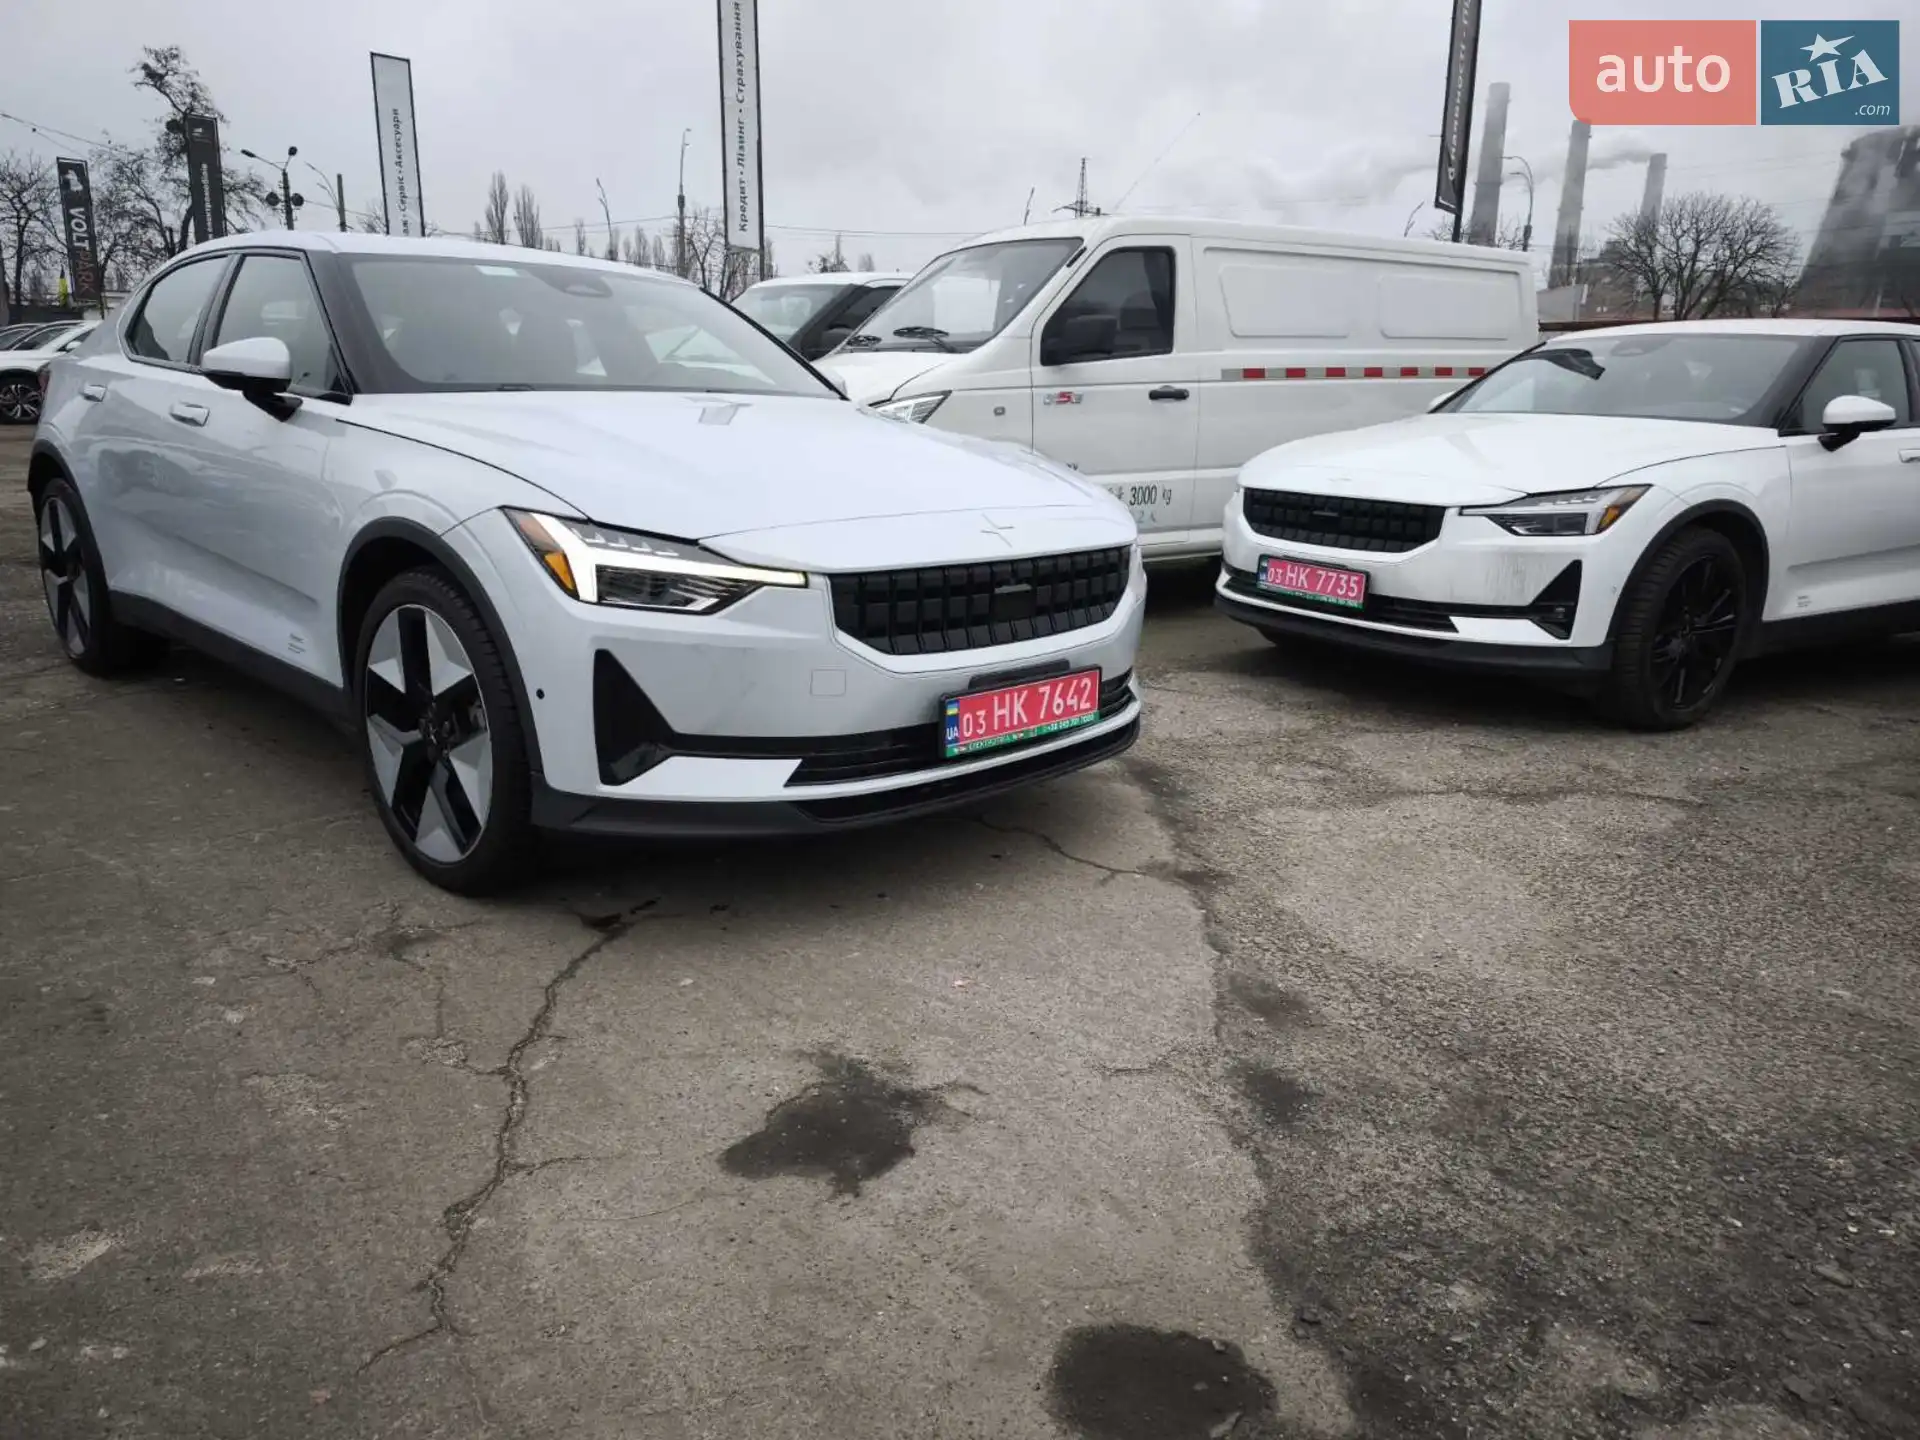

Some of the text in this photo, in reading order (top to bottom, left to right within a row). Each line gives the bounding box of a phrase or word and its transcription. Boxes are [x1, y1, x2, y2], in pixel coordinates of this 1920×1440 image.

[733, 1, 748, 232] Кредит Лізинг Страхування
[391, 108, 403, 168] Аксесуари
[396, 174, 408, 212] Сервіс
[1129, 485, 1157, 505] 3000
[1268, 563, 1360, 597] 03 HK 7735
[963, 709, 987, 738] 03
[993, 690, 1028, 731] HK
[1039, 677, 1092, 719] 7642
[946, 726, 959, 740] UA
